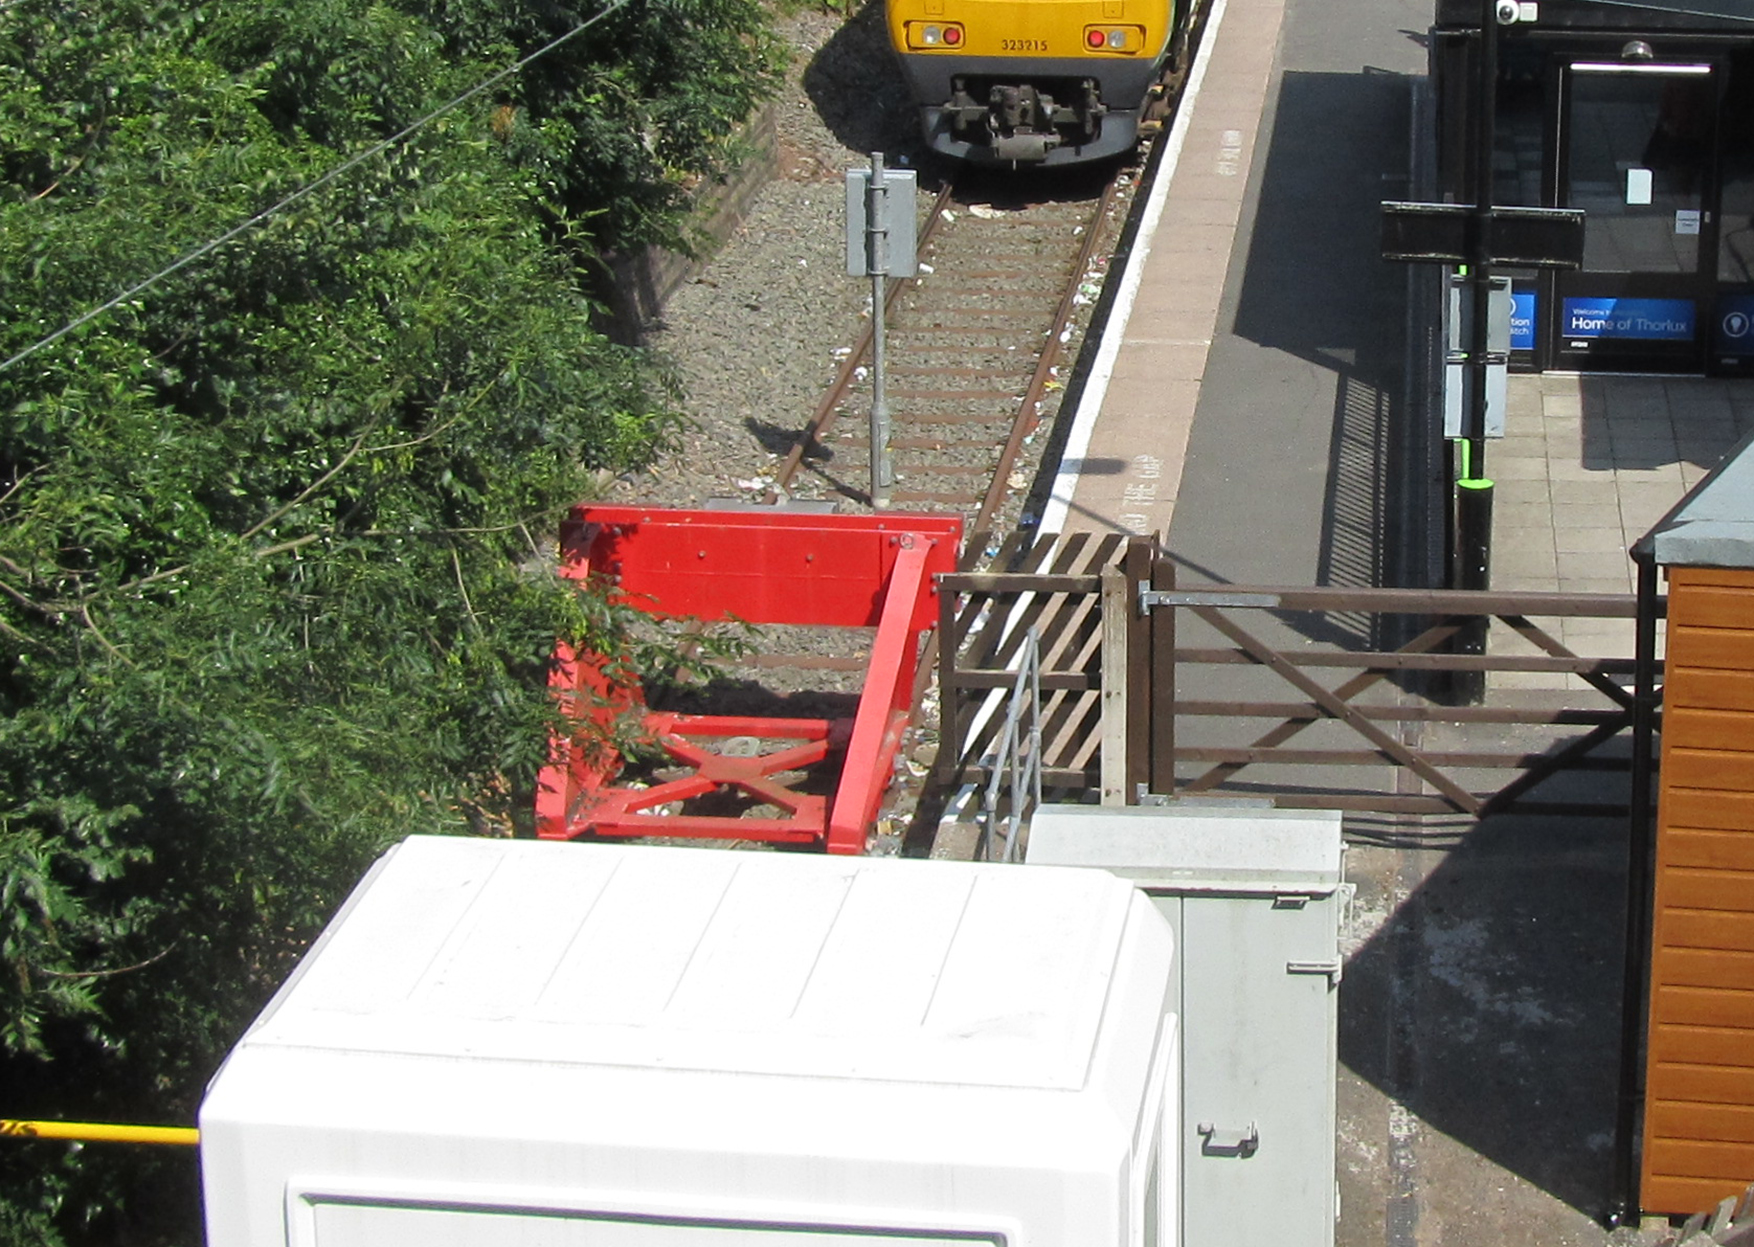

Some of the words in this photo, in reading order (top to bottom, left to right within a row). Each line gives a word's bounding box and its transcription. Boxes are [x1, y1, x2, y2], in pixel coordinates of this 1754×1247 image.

[1001, 38, 1048, 52] 323215
[1571, 316, 1613, 330] Home
[1617, 317, 1633, 330] of
[1636, 318, 1687, 332] Thorlux
